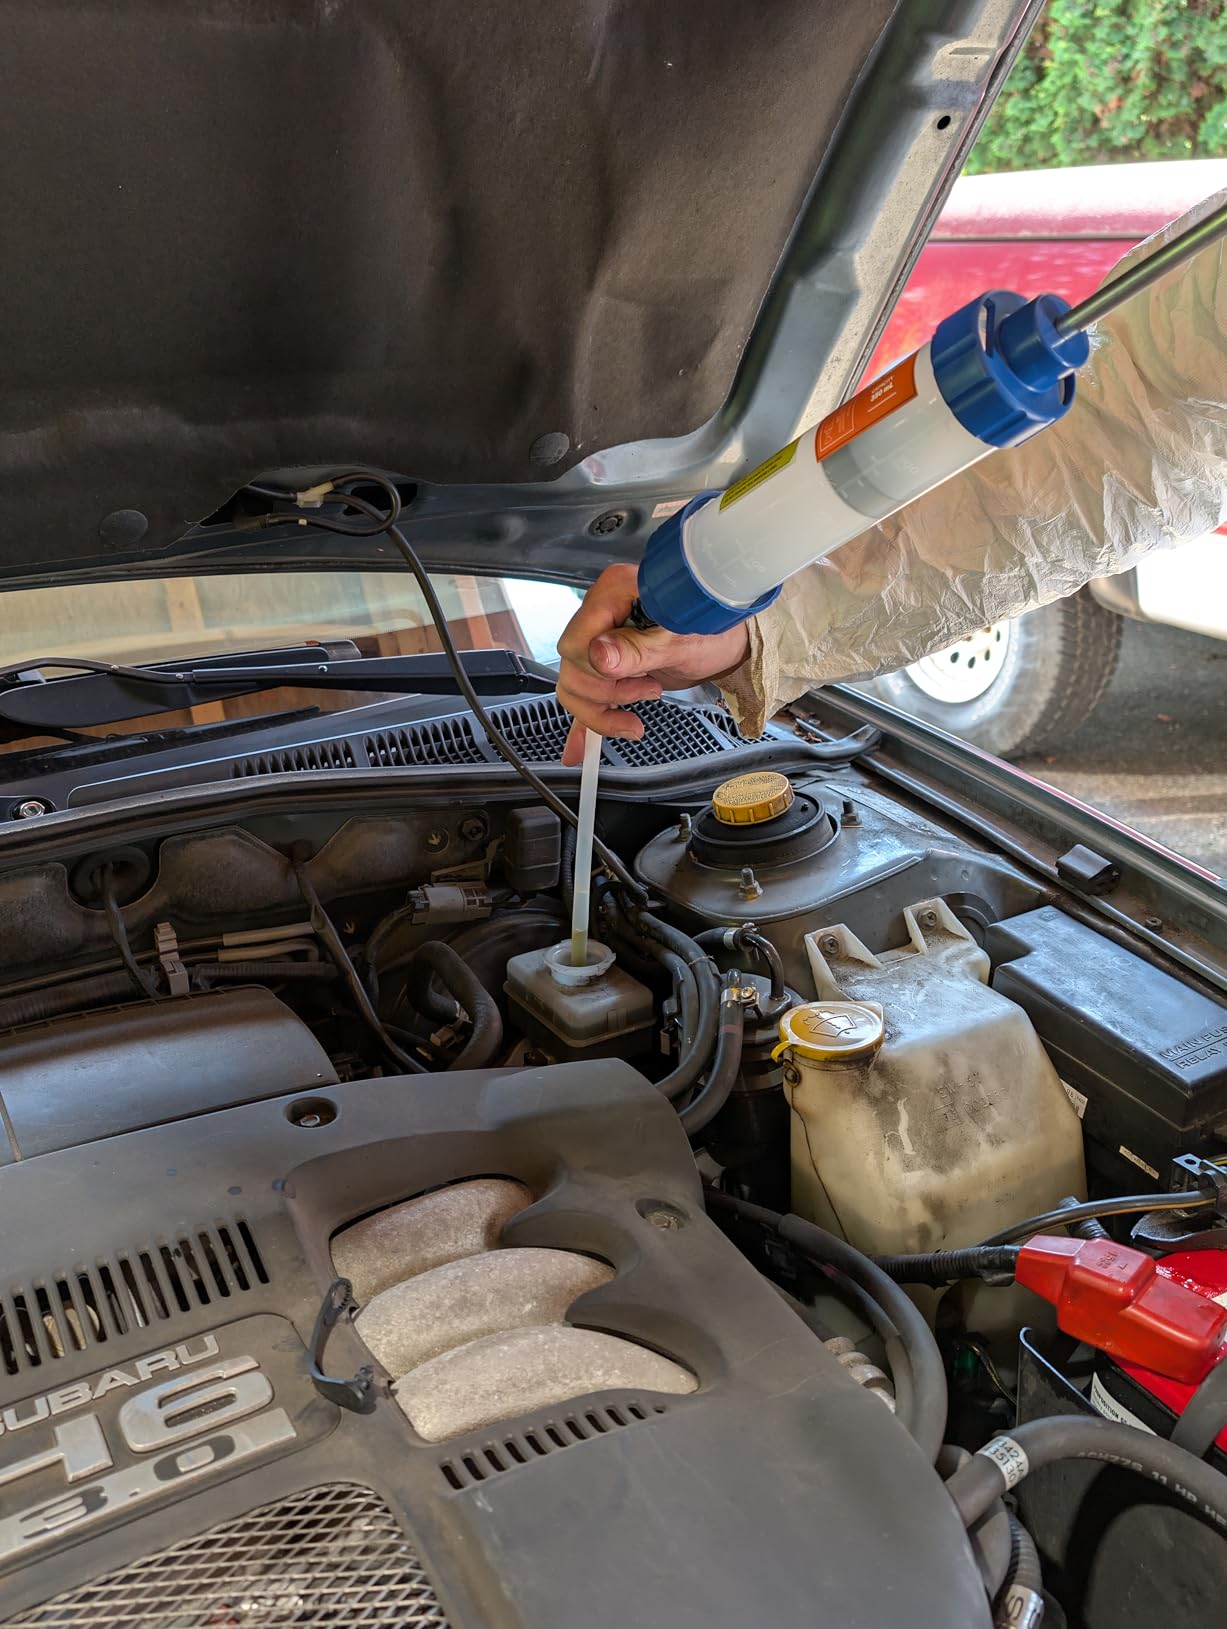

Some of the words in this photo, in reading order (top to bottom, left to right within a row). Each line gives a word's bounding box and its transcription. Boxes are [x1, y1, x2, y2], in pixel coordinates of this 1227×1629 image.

[1159, 1038, 1202, 1060] MAIN
[1174, 1048, 1222, 1070] RELAY
[0, 1334, 220, 1436] UBARU
[18, 1434, 238, 1541] 3.0
